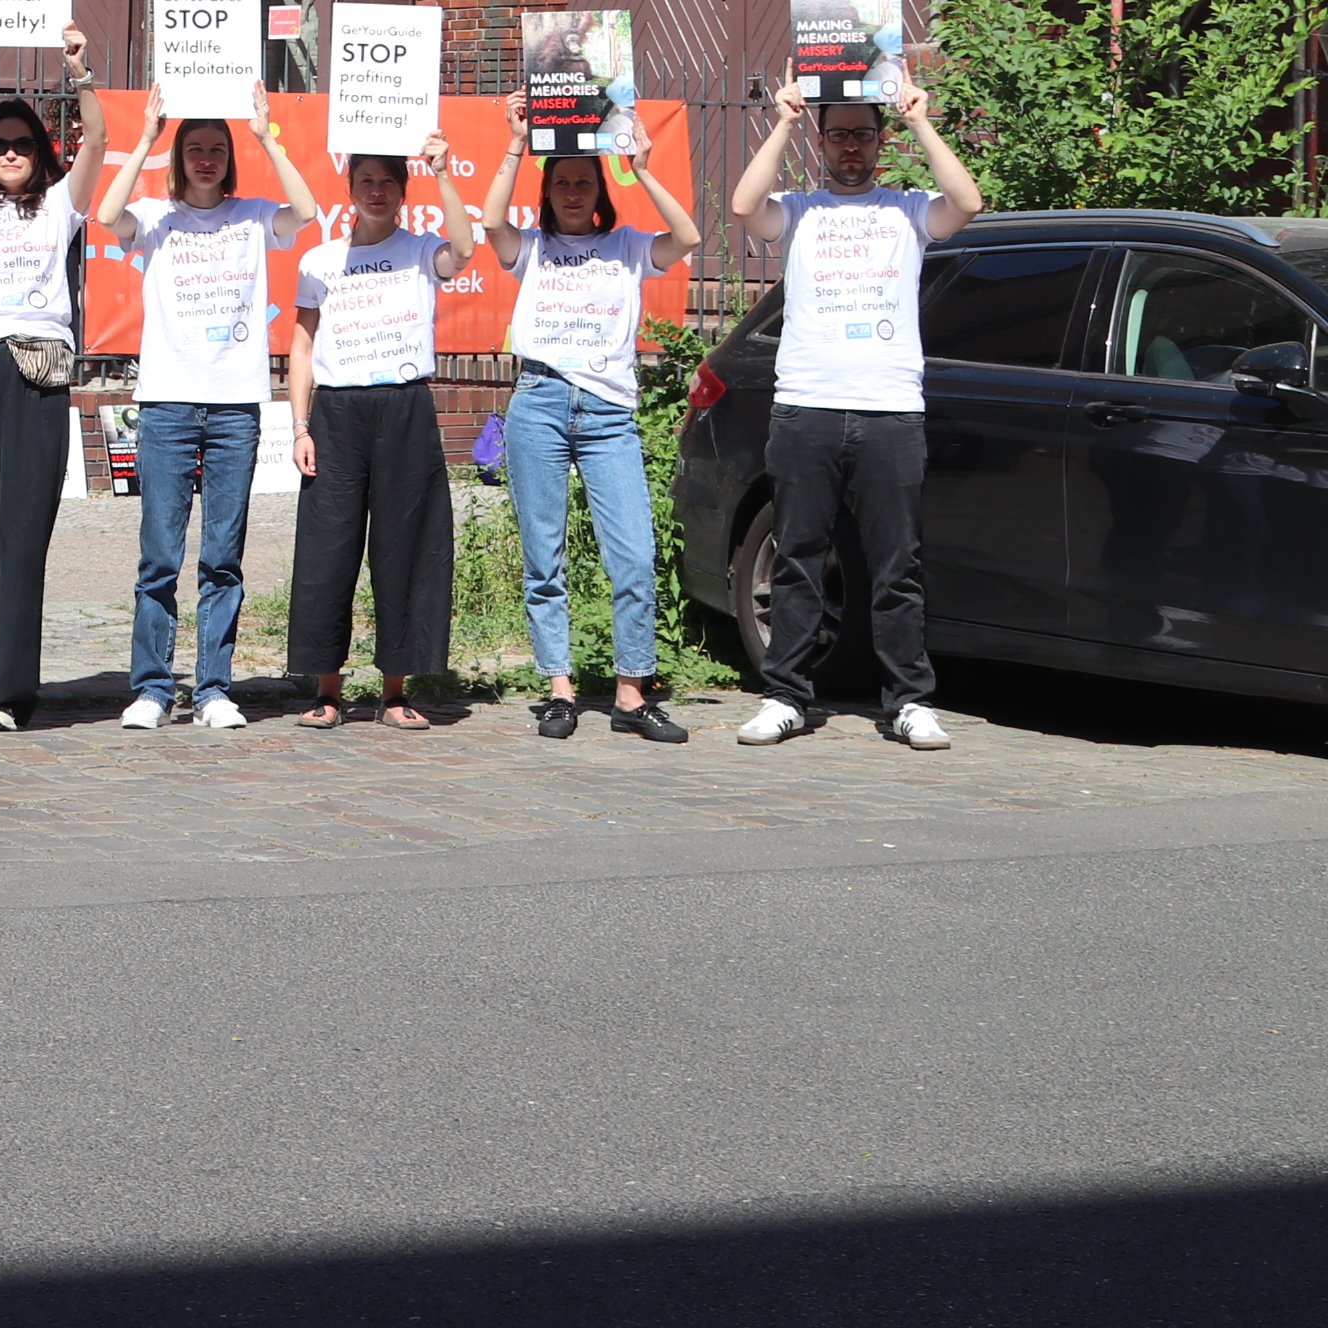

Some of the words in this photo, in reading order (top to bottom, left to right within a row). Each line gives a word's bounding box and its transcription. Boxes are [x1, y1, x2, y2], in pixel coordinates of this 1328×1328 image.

[165, 9, 228, 29] STOP
[796, 19, 853, 31] MAKING
[341, 24, 422, 37] GetYourGuide
[797, 32, 867, 44] MEMORIES
[164, 40, 221, 53] Wildlife
[342, 42, 407, 64] STOP
[798, 45, 844, 56] MISERY
[165, 61, 253, 78] Exploitation
[798, 62, 869, 72] GetYourGuide
[340, 69, 402, 88] profiting
[530, 72, 585, 84] MAKING
[339, 89, 373, 103] from
[378, 92, 428, 106] animal
[530, 85, 600, 97] MEMORIES
[531, 98, 577, 109] MISERY
[339, 110, 408, 129] suffering!
[532, 114, 601, 125] GetYourGuide
[450, 154, 475, 177] to
[172, 248, 227, 266] MISERY
[814, 244, 870, 261] MISERY
[3, 257, 41, 269] selling
[323, 259, 393, 281] MAKING
[174, 270, 255, 288] GetYourGuide
[814, 266, 900, 283] GetYourGuide
[325, 271, 411, 297] MEMORIES
[816, 286, 841, 298] Stop
[845, 284, 884, 297] selling
[176, 292, 201, 304] Stop
[204, 286, 241, 299] selling
[177, 304, 217, 318] animal
[328, 293, 384, 315] MISERY
[535, 301, 620, 316] GetYourGuide
[817, 301, 858, 314] animal
[861, 300, 901, 314] cruelty!
[332, 310, 419, 335] GetYourGuide
[534, 317, 560, 330] Stop
[564, 318, 602, 333] selling
[335, 338, 361, 350] Stop
[364, 330, 402, 345] selling
[533, 335, 573, 346] animal
[339, 350, 378, 366] animal
[381, 341, 423, 357] cruelty!
